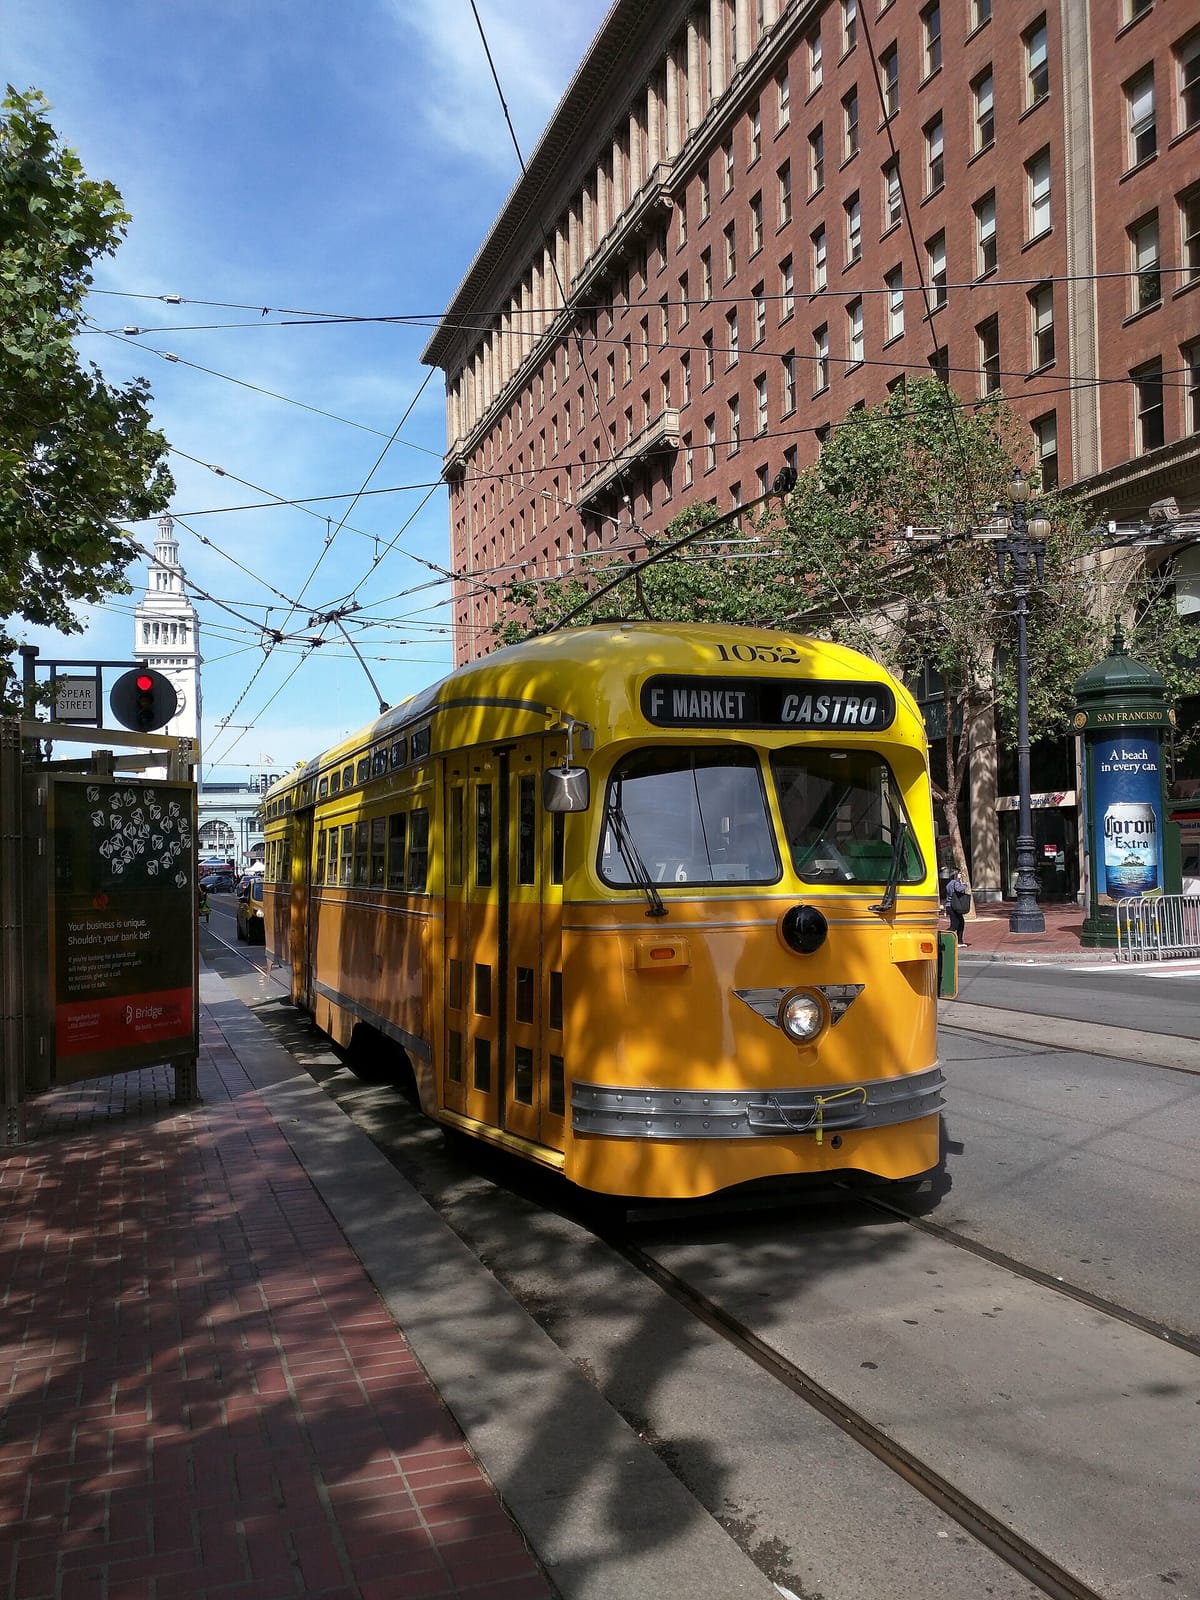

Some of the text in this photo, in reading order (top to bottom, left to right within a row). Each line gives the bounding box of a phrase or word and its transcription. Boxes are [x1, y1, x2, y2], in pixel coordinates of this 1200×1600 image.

[715, 643, 801, 664] 1052
[61, 689, 91, 698] SPEAR
[59, 700, 93, 710] STREET
[651, 689, 746, 720] F MARKET
[781, 694, 878, 725] CASTRO
[1097, 711, 1162, 722] SAN FRANCISCO
[1109, 749, 1148, 760] A beach
[1101, 762, 1158, 775] in every can.
[1115, 837, 1149, 849] Extra
[68, 918, 147, 931] Your business is unique.
[68, 931, 151, 945] Shouldn't your bank be?
[135, 1005, 163, 1020] Bridge
